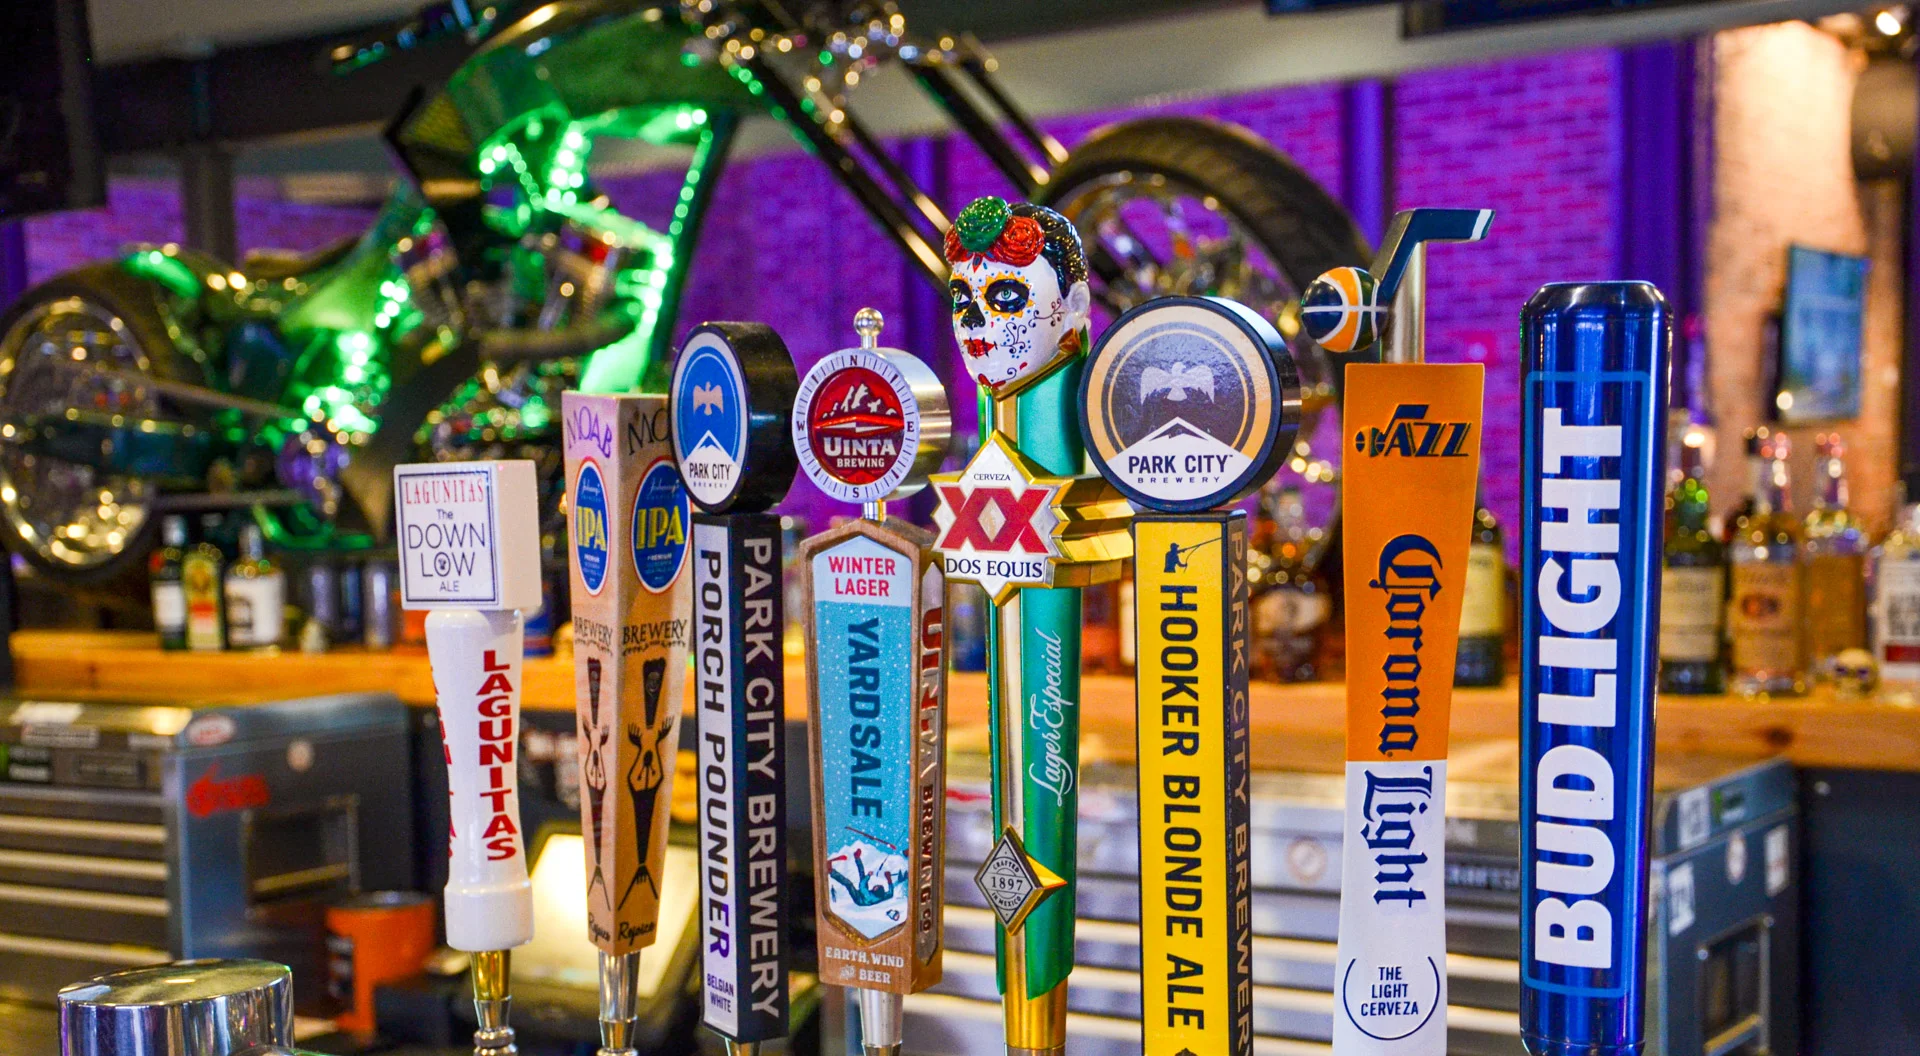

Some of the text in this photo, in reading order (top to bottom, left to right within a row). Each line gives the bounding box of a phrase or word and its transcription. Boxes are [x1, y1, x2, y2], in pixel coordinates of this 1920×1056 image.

[850, 355, 858, 366] N
[567, 406, 612, 459] MOAB
[628, 408, 669, 455] MO
[796, 420, 806, 431] W
[907, 421, 915, 432] E
[1355, 403, 1472, 458] JAZZ
[823, 437, 897, 456] UINTA
[689, 462, 731, 480] PARK CITY
[837, 458, 885, 468] BREWING
[1128, 454, 1228, 474] PARK CITY
[974, 473, 1011, 481] CERVEZA
[1137, 476, 1220, 484] BREWERY
[405, 478, 484, 505] LAGUNITAS
[852, 487, 860, 498] S
[437, 508, 453, 520] The
[940, 486, 1050, 554] XX
[407, 523, 486, 549] DOWN
[577, 506, 607, 552] IPA
[636, 505, 685, 550] IPA
[421, 552, 475, 577] LOW
[828, 556, 896, 576] WINTER
[946, 558, 1043, 578] DOS EQUIS
[439, 581, 460, 592] ALE
[835, 577, 889, 597] LAGER
[1231, 530, 1245, 675] PARK
[575, 616, 613, 646] BREWERY
[623, 619, 687, 644] BREWERY
[1368, 533, 1443, 756] Corona
[1535, 408, 1622, 969] BUD LIGHT
[847, 617, 883, 819] YARDSALE
[1029, 627, 1074, 807] Lager Especial
[476, 650, 518, 861] LAGUNITAS
[701, 549, 730, 959] PORCH POUNDER
[1232, 690, 1247, 805] CITY
[743, 537, 779, 1019] PARK CITY BREWERY
[1160, 585, 1205, 1030] HOOKER BLONDE ALE
[1360, 765, 1433, 908] Light
[993, 860, 1019, 873] CRAFTED
[991, 877, 1023, 891] 1897
[992, 892, 1021, 907] IN MEXICO
[825, 946, 905, 968] EARTH, WIND
[859, 968, 891, 984] BEER
[1378, 966, 1402, 981] THE
[707, 973, 734, 997] BELGIAN
[1371, 983, 1409, 999] LIGHT
[710, 992, 732, 1013] WHITE
[1361, 1001, 1419, 1017] CERVEZA
